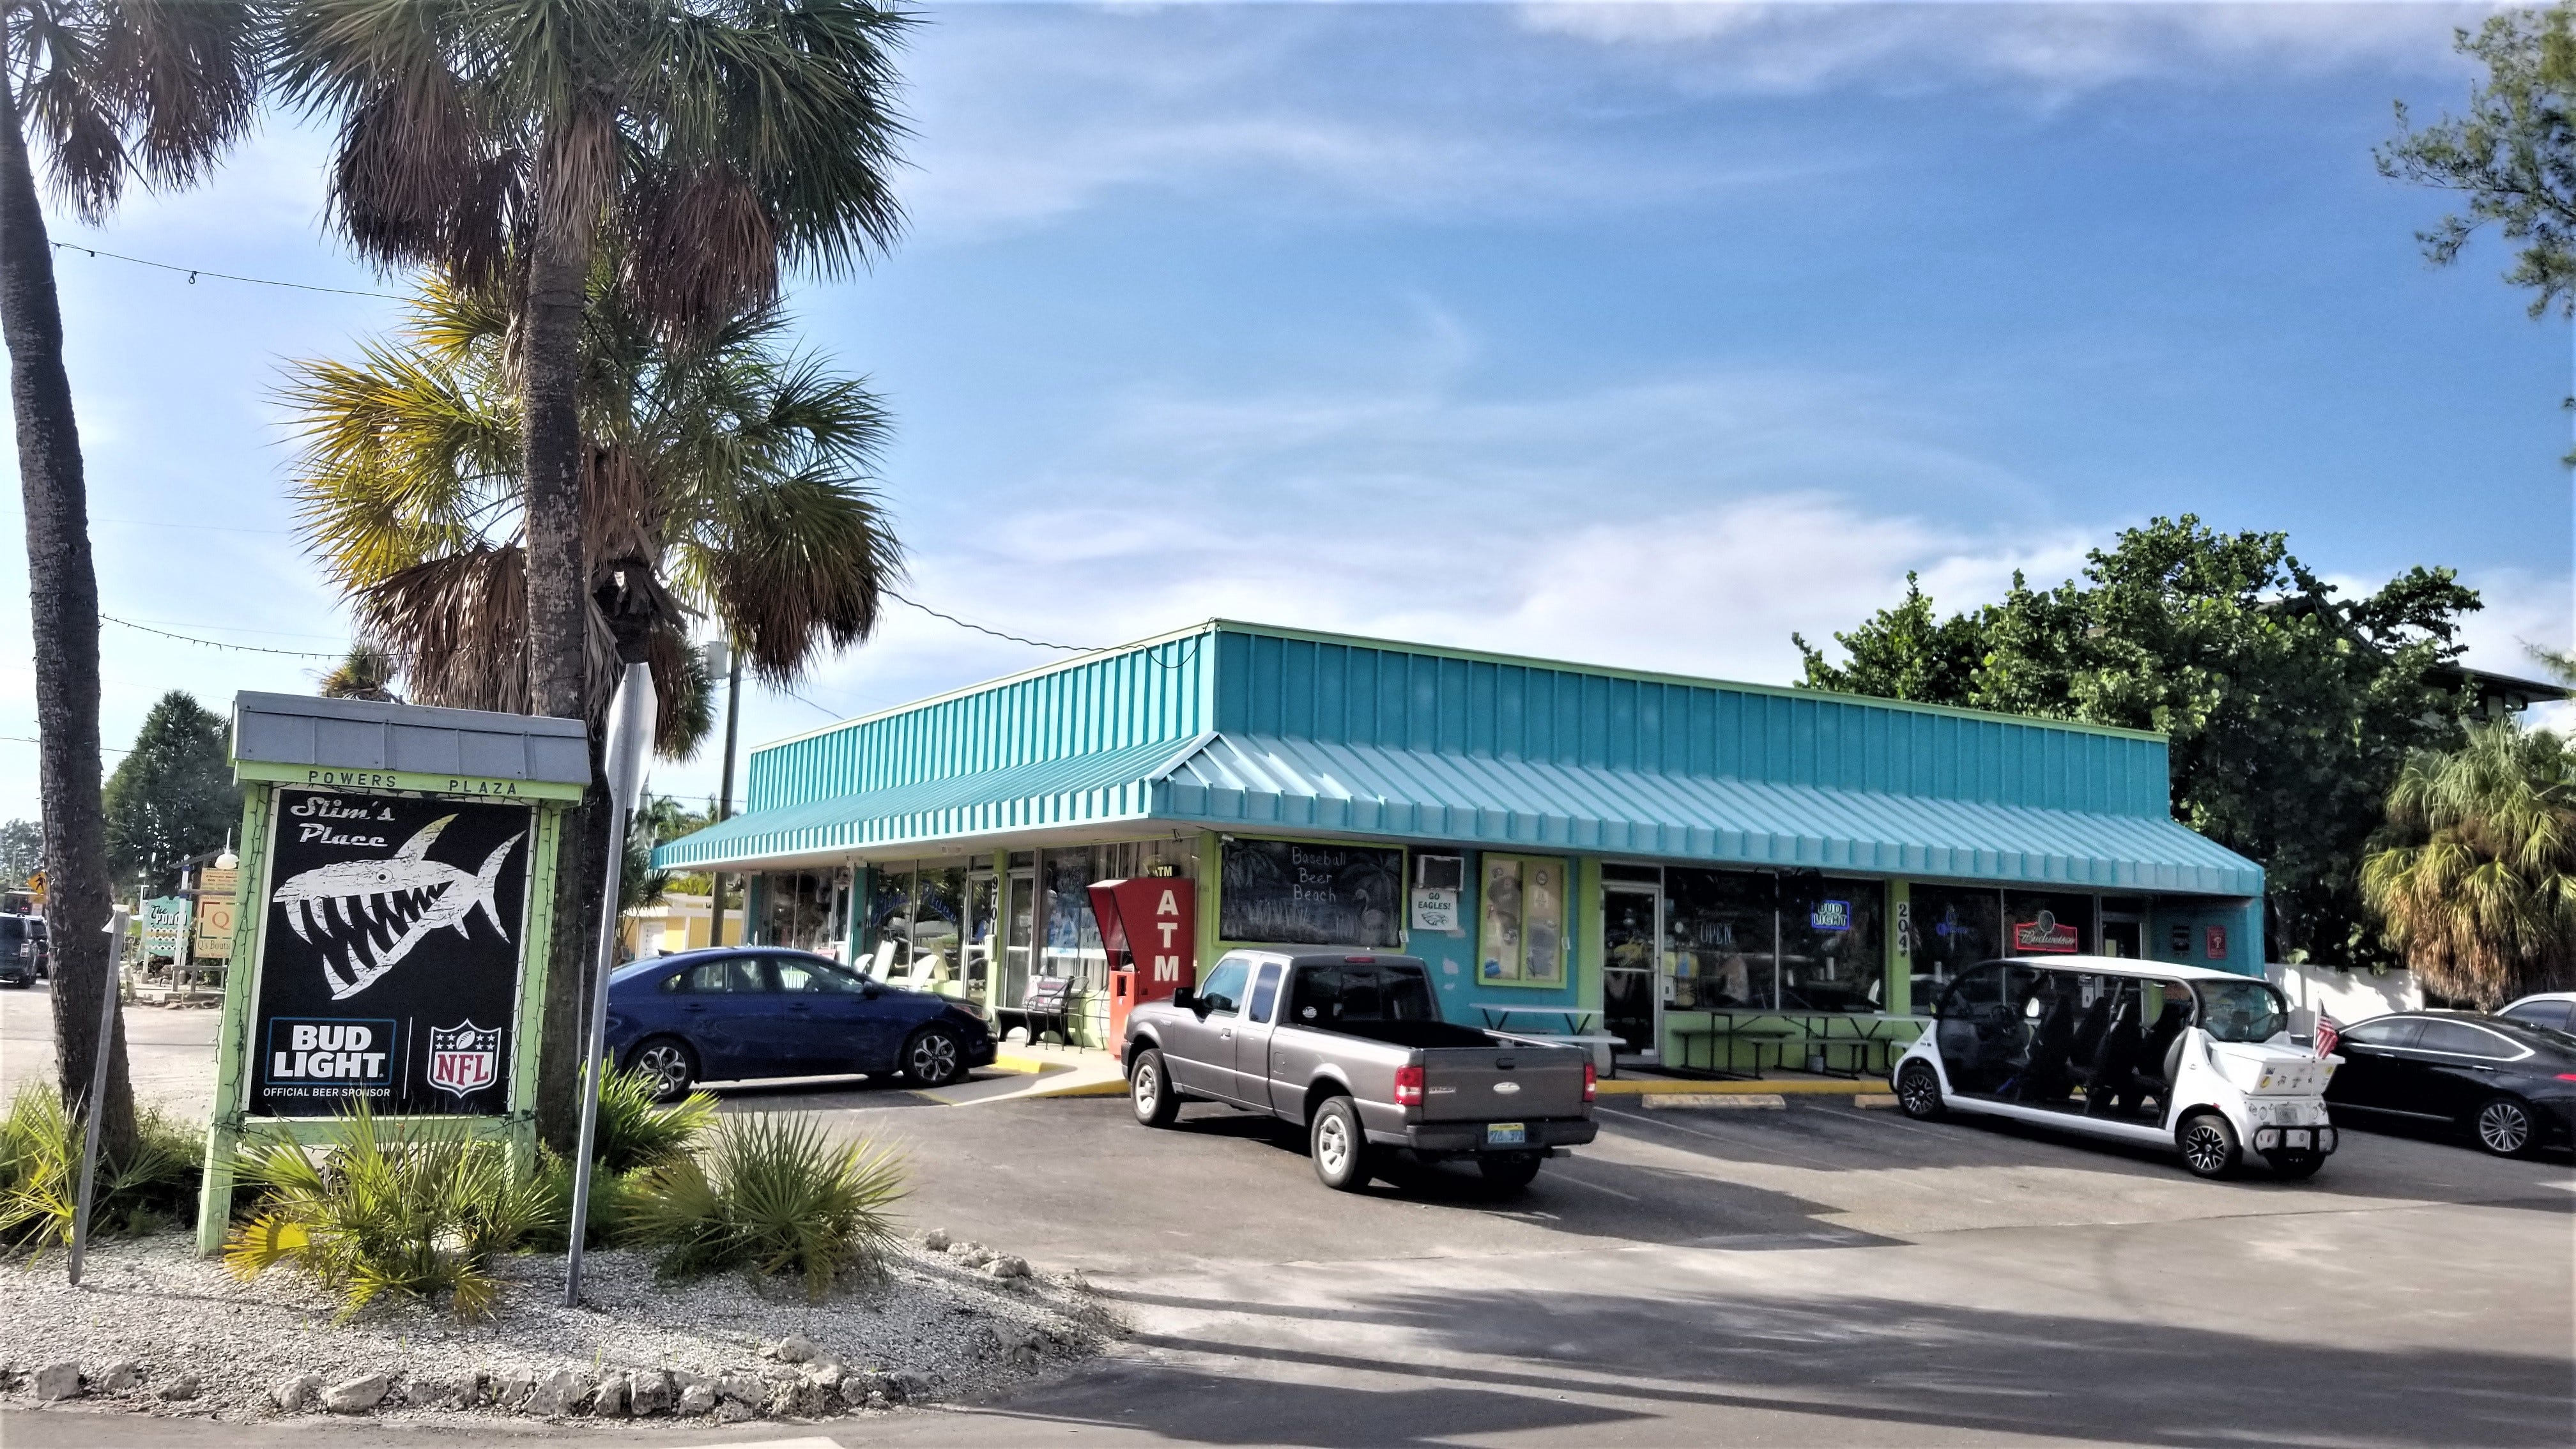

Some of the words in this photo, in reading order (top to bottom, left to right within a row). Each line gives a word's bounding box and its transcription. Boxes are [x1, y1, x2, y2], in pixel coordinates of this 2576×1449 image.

[309, 770, 395, 788] POWERS
[449, 780, 516, 795] PLAZA
[290, 797, 395, 821] Slim's
[299, 823, 388, 847] Place
[1292, 847, 1346, 866] Baseball
[1298, 867, 1332, 883] Beer
[1292, 884, 1336, 903] Beach
[150, 905, 168, 919] The
[1418, 901, 1451, 910] EAGLES!
[1818, 903, 1843, 914] BUD
[212, 911, 231, 930] Q
[1813, 914, 1847, 926] LIGHT
[1154, 889, 1179, 981] ATM
[1700, 924, 1732, 944] OPEN
[2018, 930, 2075, 945] Budweiser
[292, 1025, 372, 1051] BUD
[273, 1052, 385, 1078] LIGHT
[436, 1054, 489, 1086] NFL
[263, 1087, 310, 1097] OFFICIAL
[312, 1088, 339, 1097] BEER
[341, 1088, 390, 1097] SPONSOR
